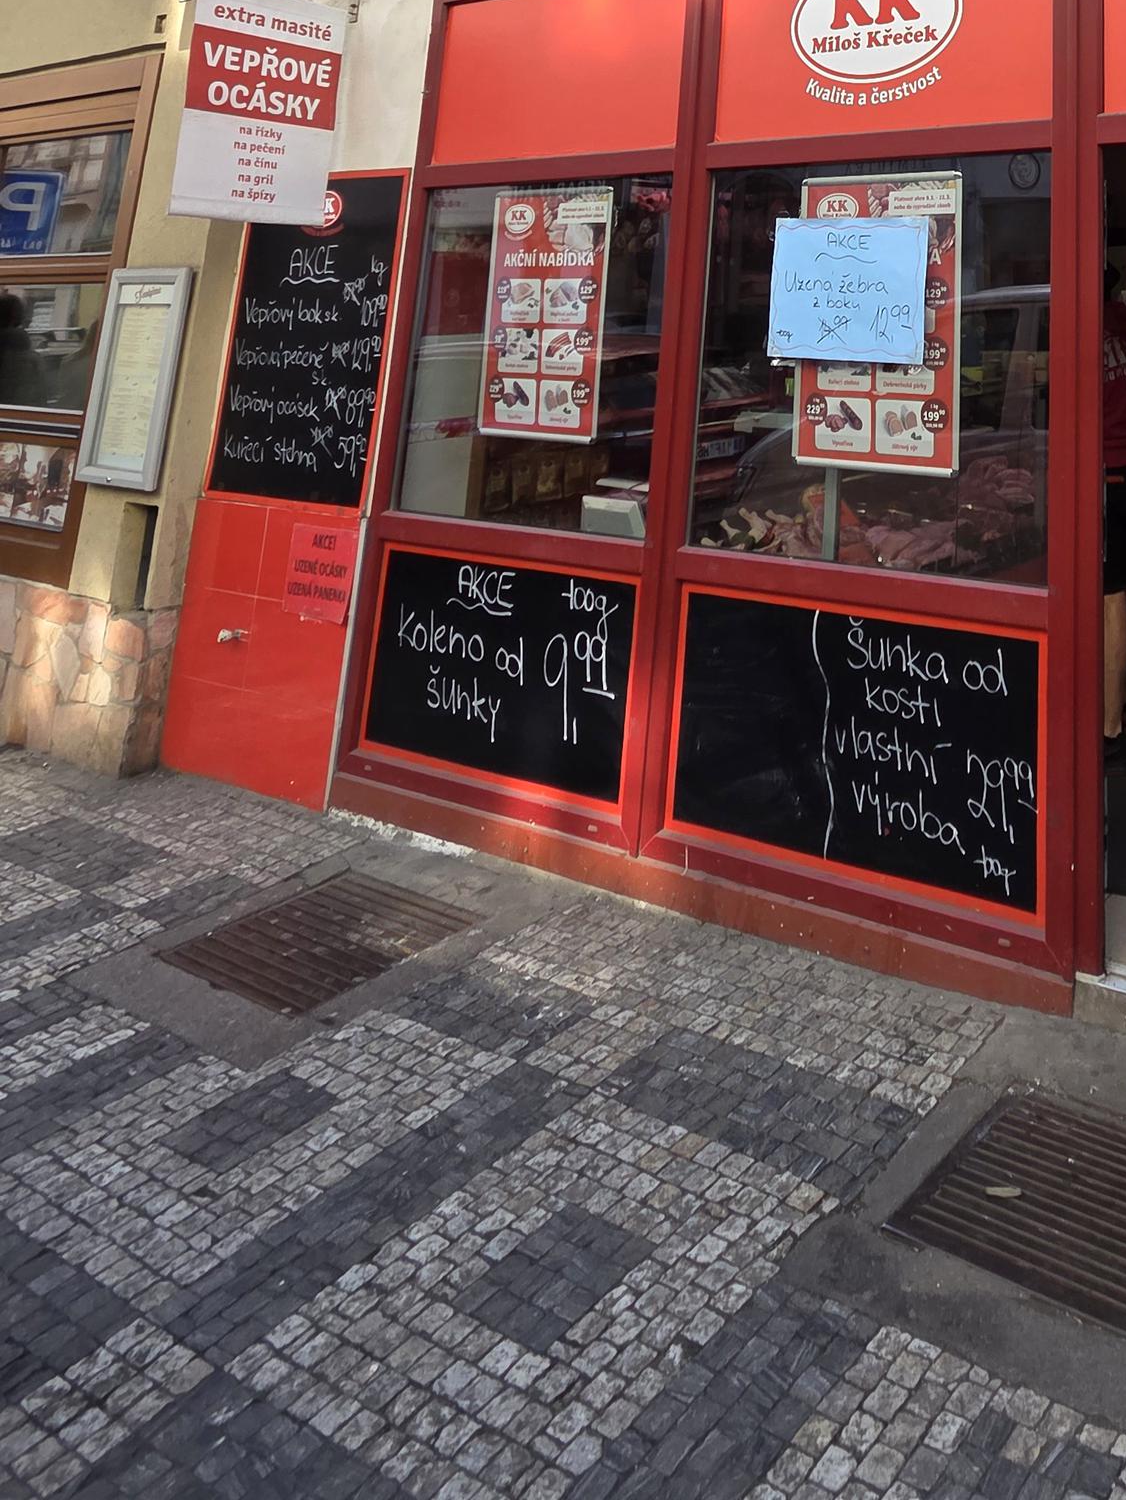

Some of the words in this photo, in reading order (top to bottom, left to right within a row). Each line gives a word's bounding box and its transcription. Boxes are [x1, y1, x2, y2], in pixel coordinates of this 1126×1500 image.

[214, 4, 265, 27] extra
[271, 17, 332, 41] masité
[811, 32, 862, 55] Miloš
[866, 24, 939, 49] Křeček
[204, 41, 332, 88] VEPŘOVÉ
[805, 77, 855, 106] Kvalita
[857, 93, 867, 106] a
[870, 65, 942, 105] čerstvost
[208, 81, 320, 121] OCÁSKY
[239, 125, 252, 135] na
[255, 125, 282, 142] řízky
[233, 141, 247, 150] na
[250, 141, 285, 155] pečení
[238, 157, 251, 167] na
[254, 156, 277, 170] čínu
[238, 173, 251, 183] na
[254, 173, 274, 187] gril
[231, 188, 245, 198] na
[511, 210, 528, 221] KK
[827, 199, 849, 213] KK
[827, 232, 872, 251] AKCE
[289, 244, 340, 277] AKCE
[371, 255, 388, 286] kg
[504, 248, 538, 267] AKČNÍ
[539, 248, 595, 267] NABÍDKA
[784, 270, 833, 293] Uzená
[838, 273, 889, 295] žebra
[245, 297, 295, 331] Vepřový
[813, 297, 821, 308] z
[826, 294, 861, 311] boku
[458, 564, 516, 608] AKCE
[398, 602, 485, 662] Koleno
[495, 636, 524, 686] od
[847, 615, 949, 685] Šunka
[962, 648, 1008, 697] od
